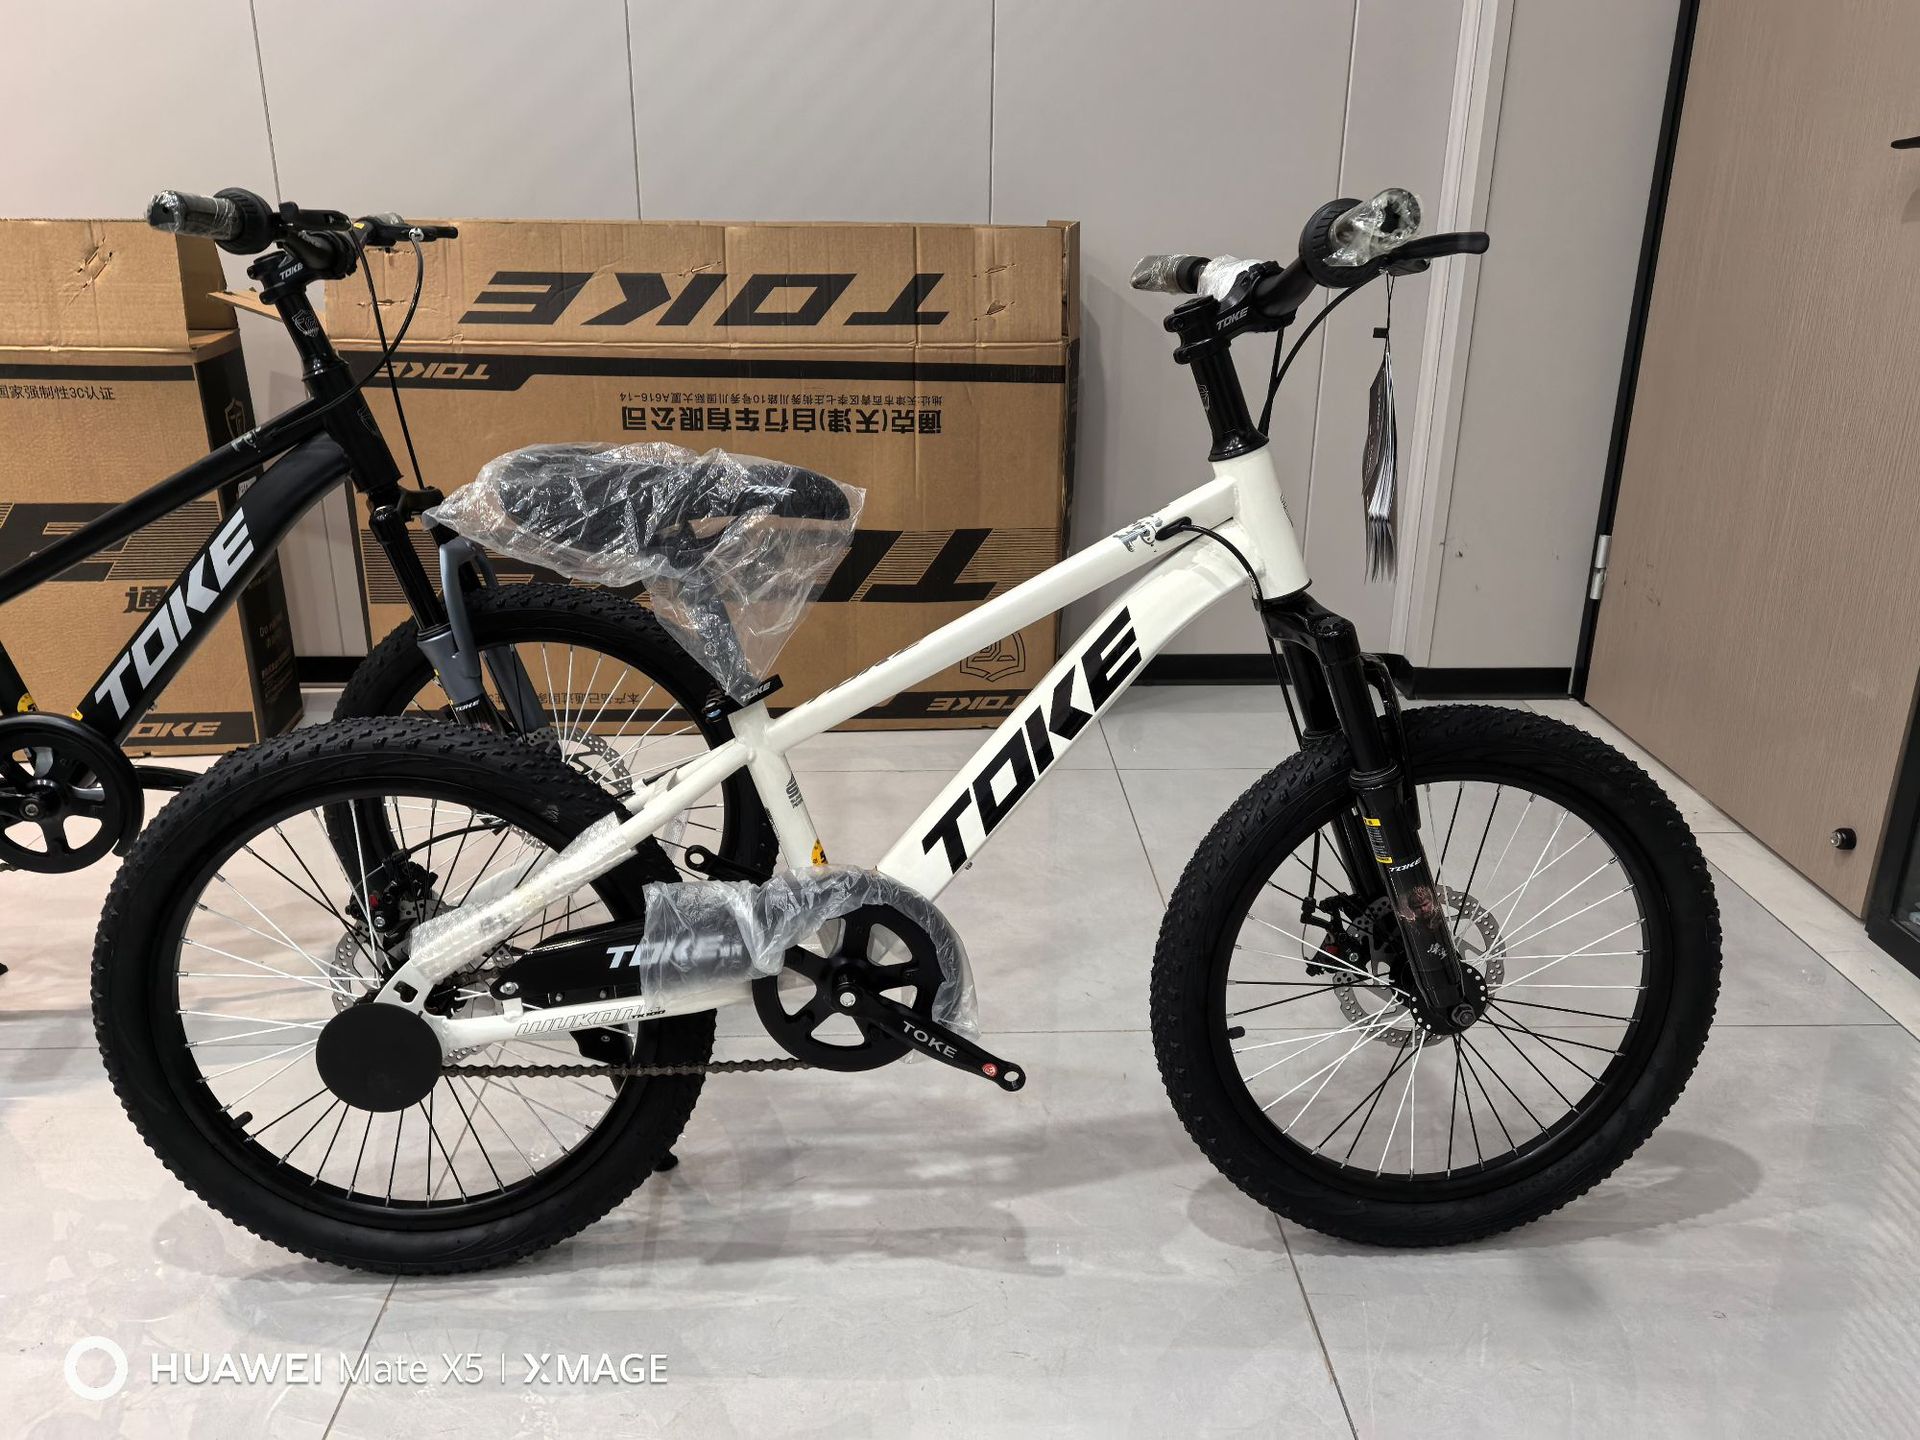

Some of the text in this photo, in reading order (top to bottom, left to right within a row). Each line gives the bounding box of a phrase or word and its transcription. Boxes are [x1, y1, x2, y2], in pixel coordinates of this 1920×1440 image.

[279, 262, 304, 280] TOKE
[458, 271, 950, 327] TOKE
[1216, 306, 1249, 331] TOKE
[374, 361, 491, 380] TOKE
[95, 507, 254, 720] TOKE
[741, 681, 771, 702] TOKE
[454, 699, 480, 712] TOKE
[128, 721, 222, 738] OKE
[921, 605, 1142, 875] TOKE
[1389, 856, 1422, 873] TOKE
[606, 935, 724, 969] TOKE
[903, 1020, 958, 1059] TOKE
